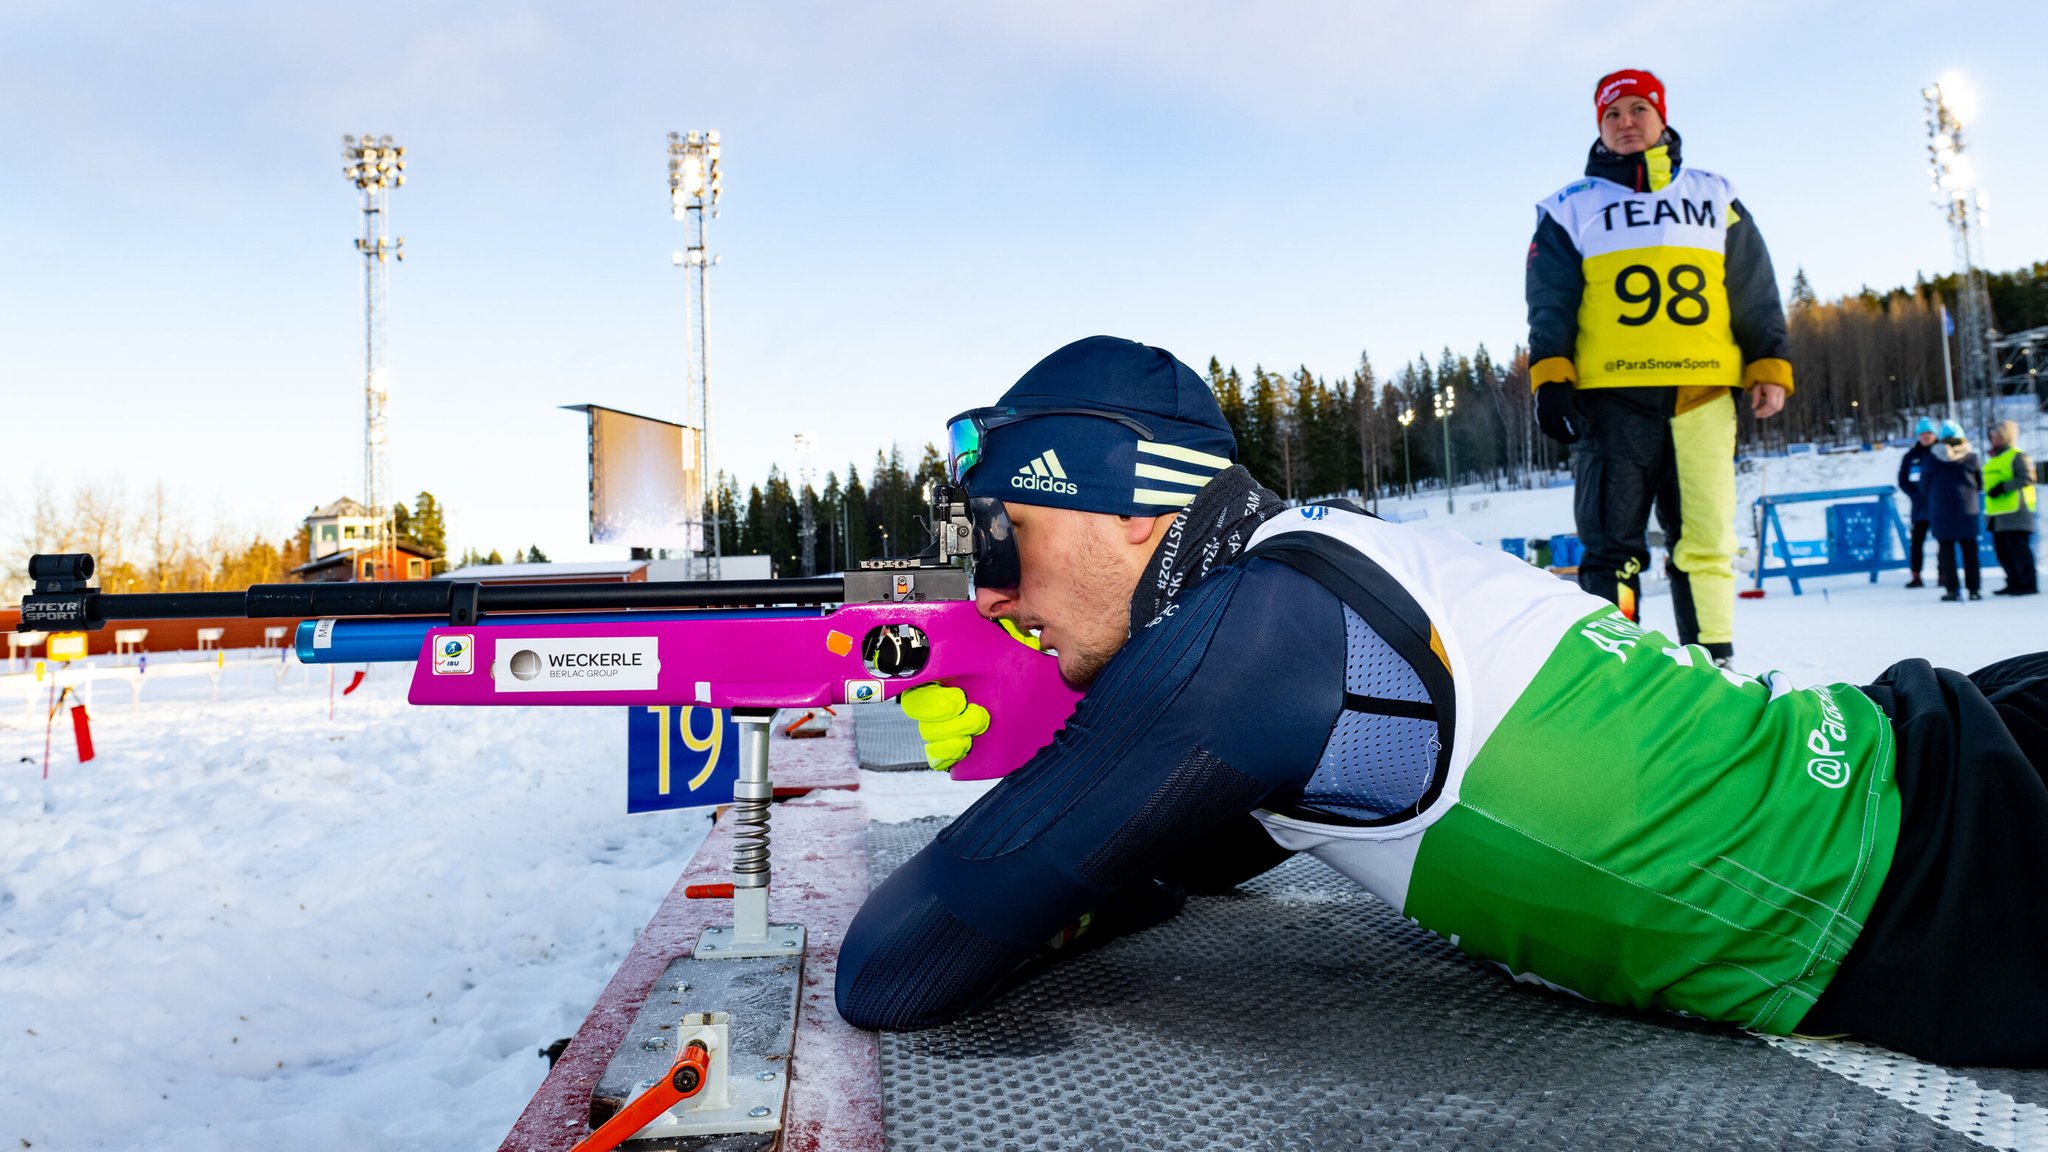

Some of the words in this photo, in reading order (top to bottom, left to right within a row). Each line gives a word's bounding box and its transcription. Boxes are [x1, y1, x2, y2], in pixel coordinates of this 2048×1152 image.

[1598, 198, 1716, 231] TEAM
[1615, 264, 1709, 326] 98
[1604, 358, 1720, 373] @ParaSnowSports
[1011, 474, 1078, 495] adidas
[24, 603, 79, 612] STEYR
[25, 611, 77, 621] SPORT
[548, 653, 642, 667] WECKERLE
[549, 669, 585, 678] BERLAC
[586, 669, 619, 678] GROUP
[647, 705, 723, 795] 19
